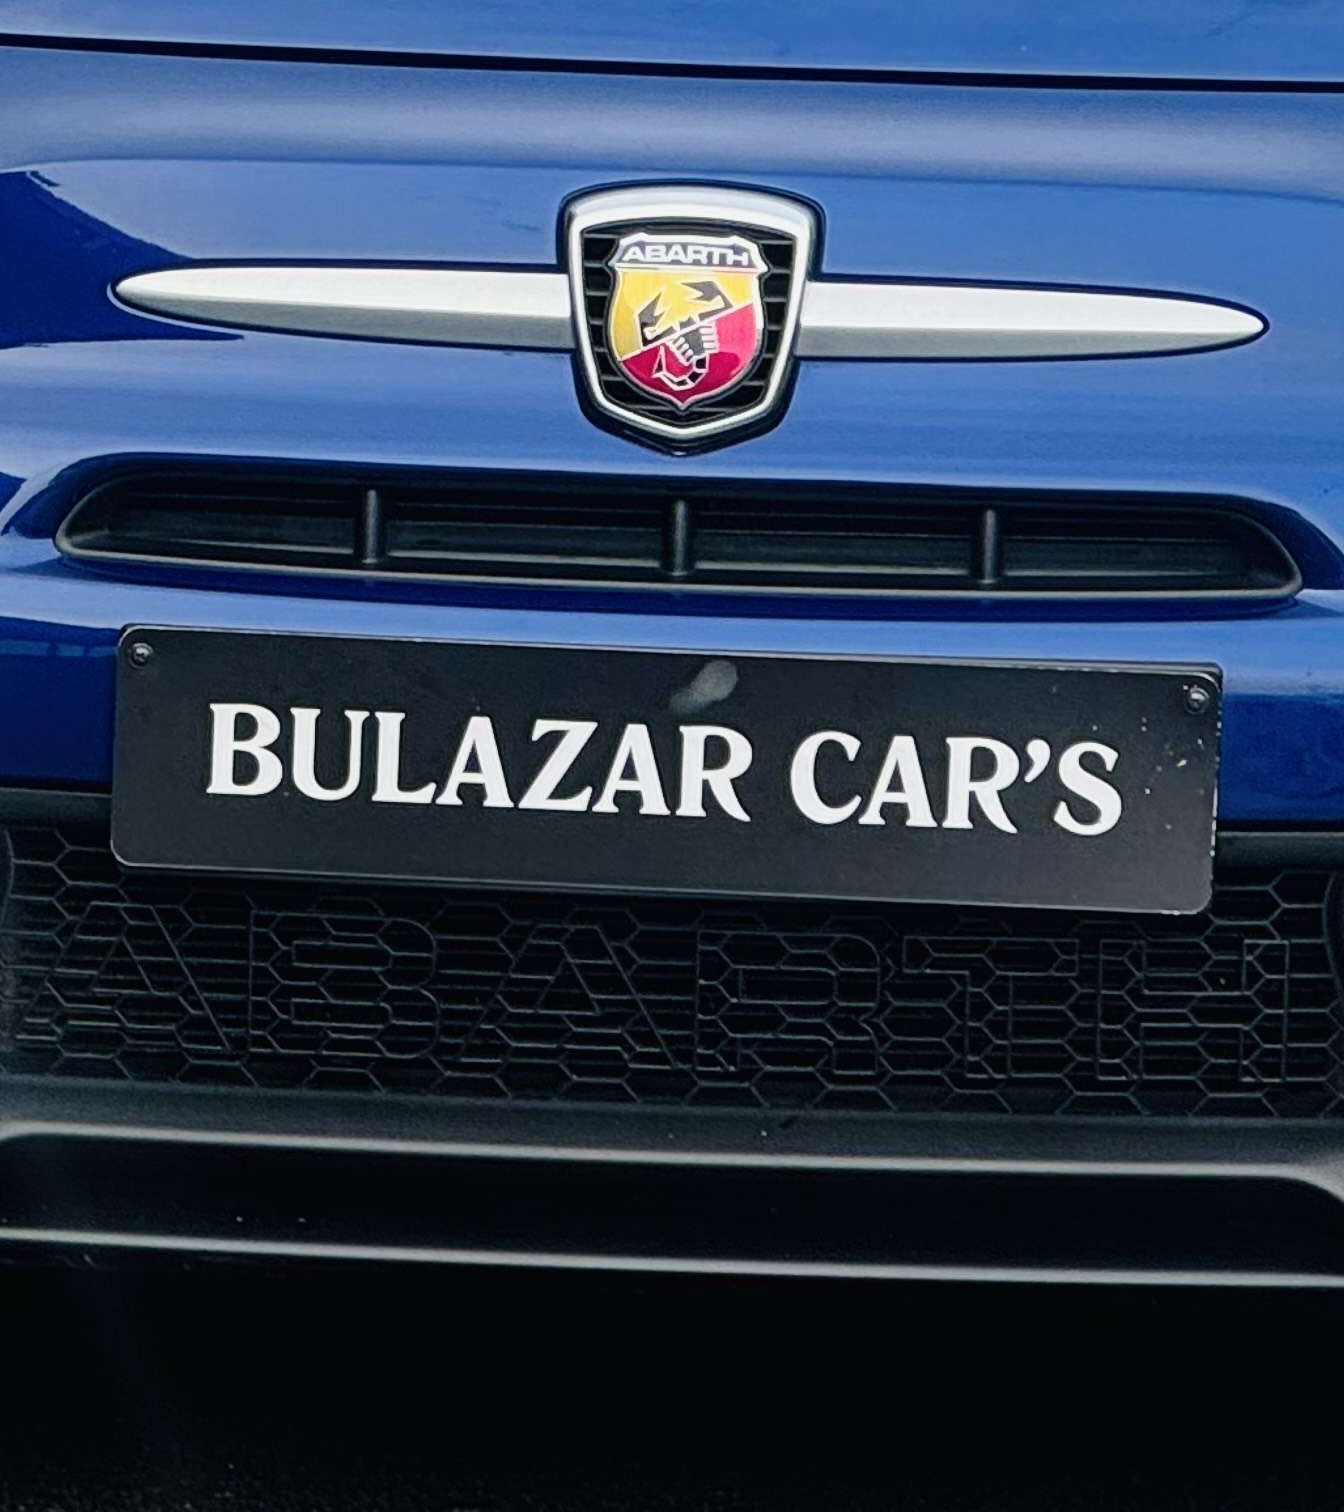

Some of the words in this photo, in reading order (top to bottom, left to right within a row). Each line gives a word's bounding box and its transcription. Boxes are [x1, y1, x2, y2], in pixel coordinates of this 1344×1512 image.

[622, 244, 749, 265] ABARTH
[206, 701, 752, 823] BULAZAR
[788, 729, 1122, 837] CAR'S
